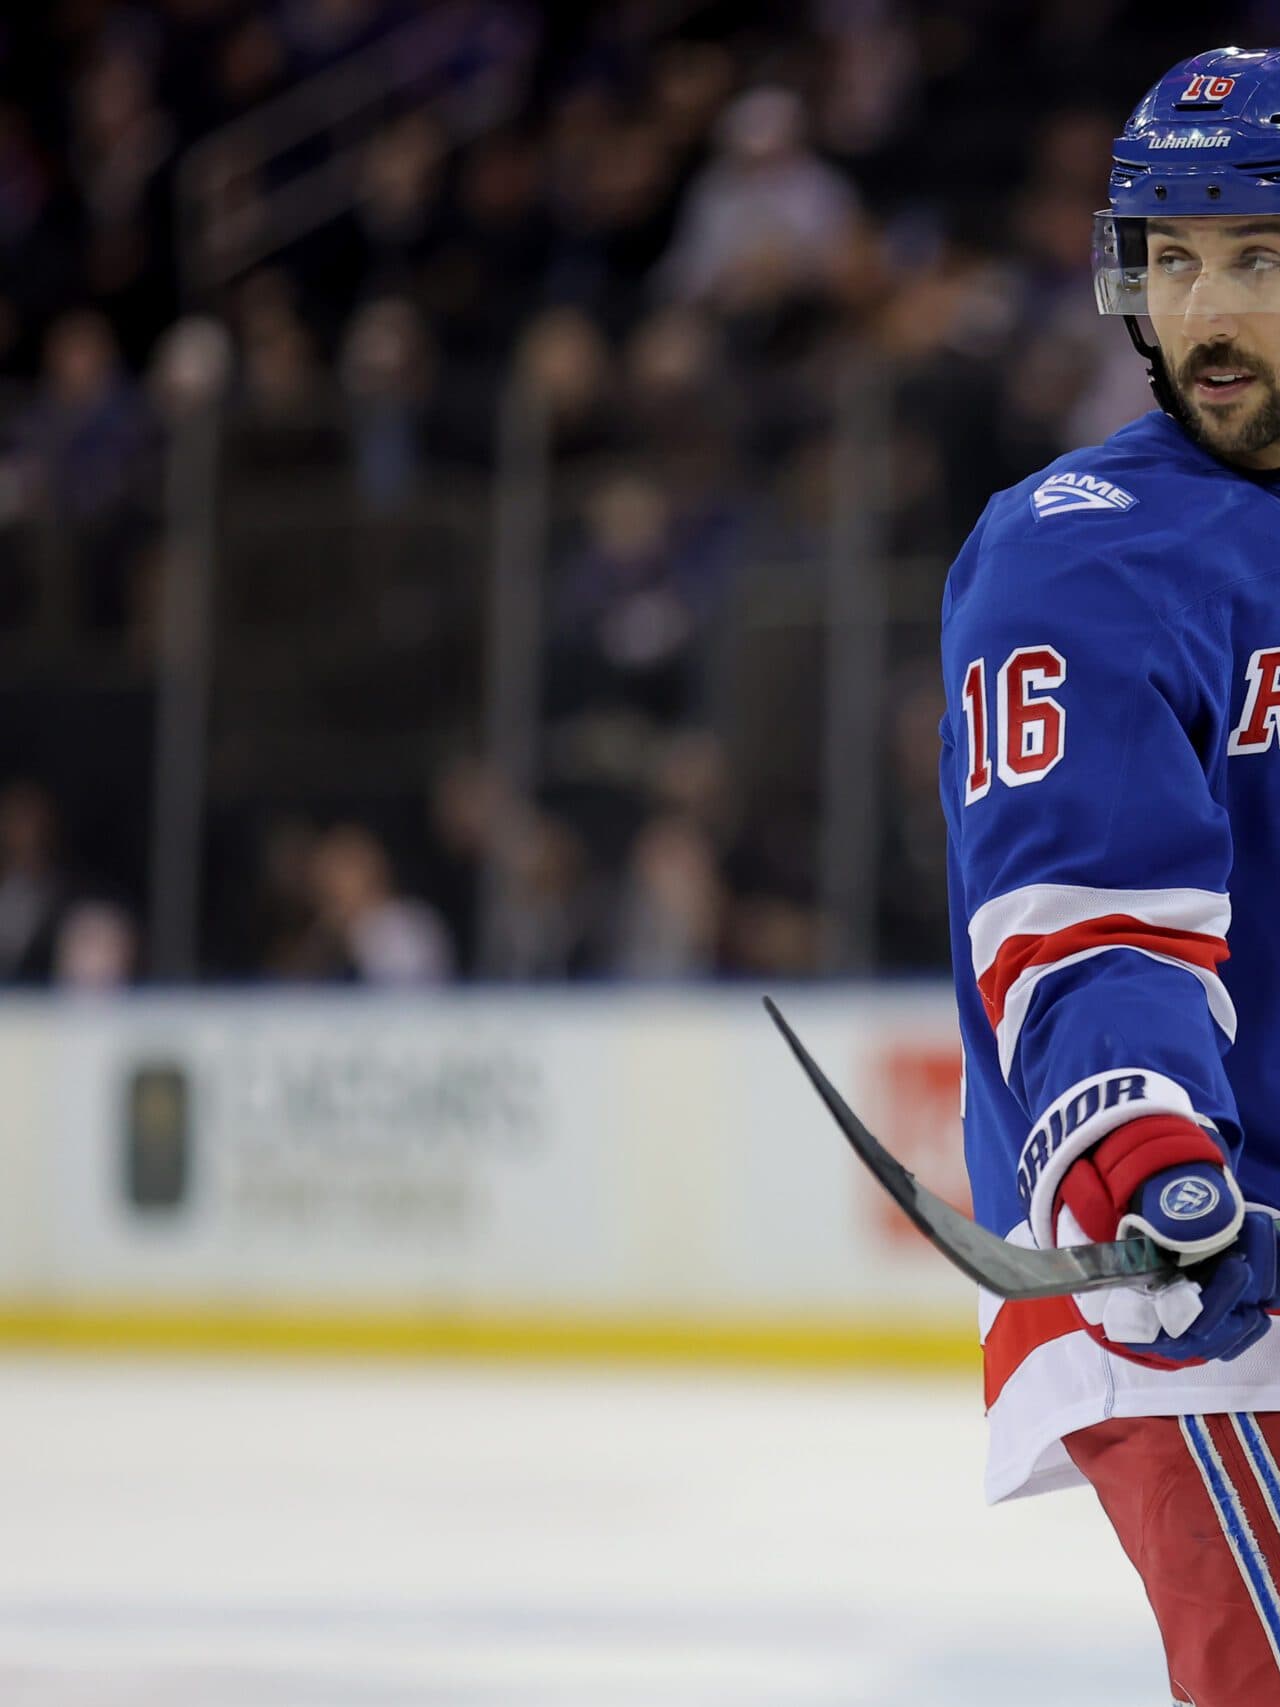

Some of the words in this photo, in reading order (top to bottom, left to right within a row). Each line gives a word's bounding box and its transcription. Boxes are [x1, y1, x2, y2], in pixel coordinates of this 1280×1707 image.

[1181, 76, 1235, 101] 16
[1148, 136, 1231, 149] WARRIOR
[1040, 472, 1134, 509] AME
[962, 644, 1067, 806] 16
